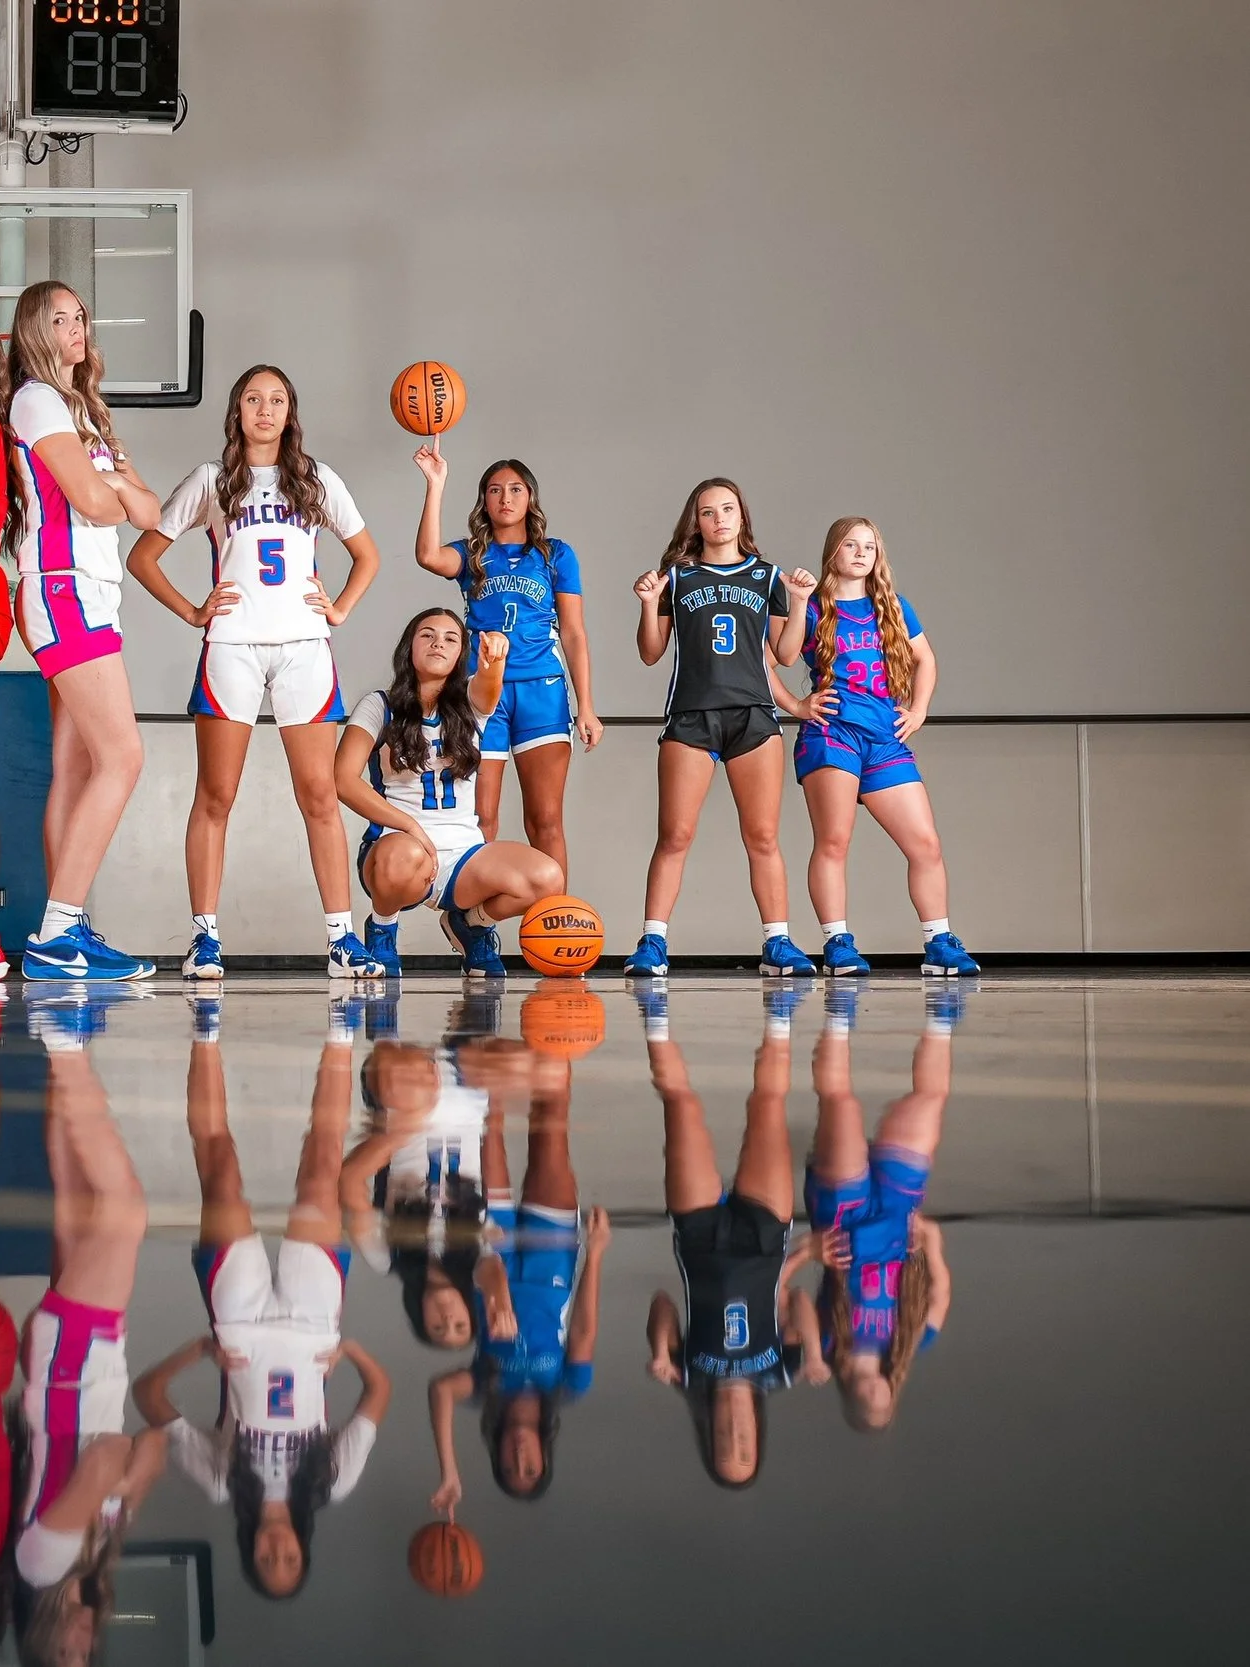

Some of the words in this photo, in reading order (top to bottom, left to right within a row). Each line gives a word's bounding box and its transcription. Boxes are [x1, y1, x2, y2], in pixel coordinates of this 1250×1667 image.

[408, 384, 420, 416] EVO
[430, 372, 447, 424] Wilson
[257, 538, 286, 586] 5
[680, 586, 717, 613] THE
[718, 584, 766, 614] TOWN
[502, 602, 517, 632] 1
[711, 613, 737, 656] 3
[846, 661, 890, 699] 22
[421, 768, 457, 810] 11
[542, 914, 597, 931] Wilson
[554, 946, 589, 957] EVO
